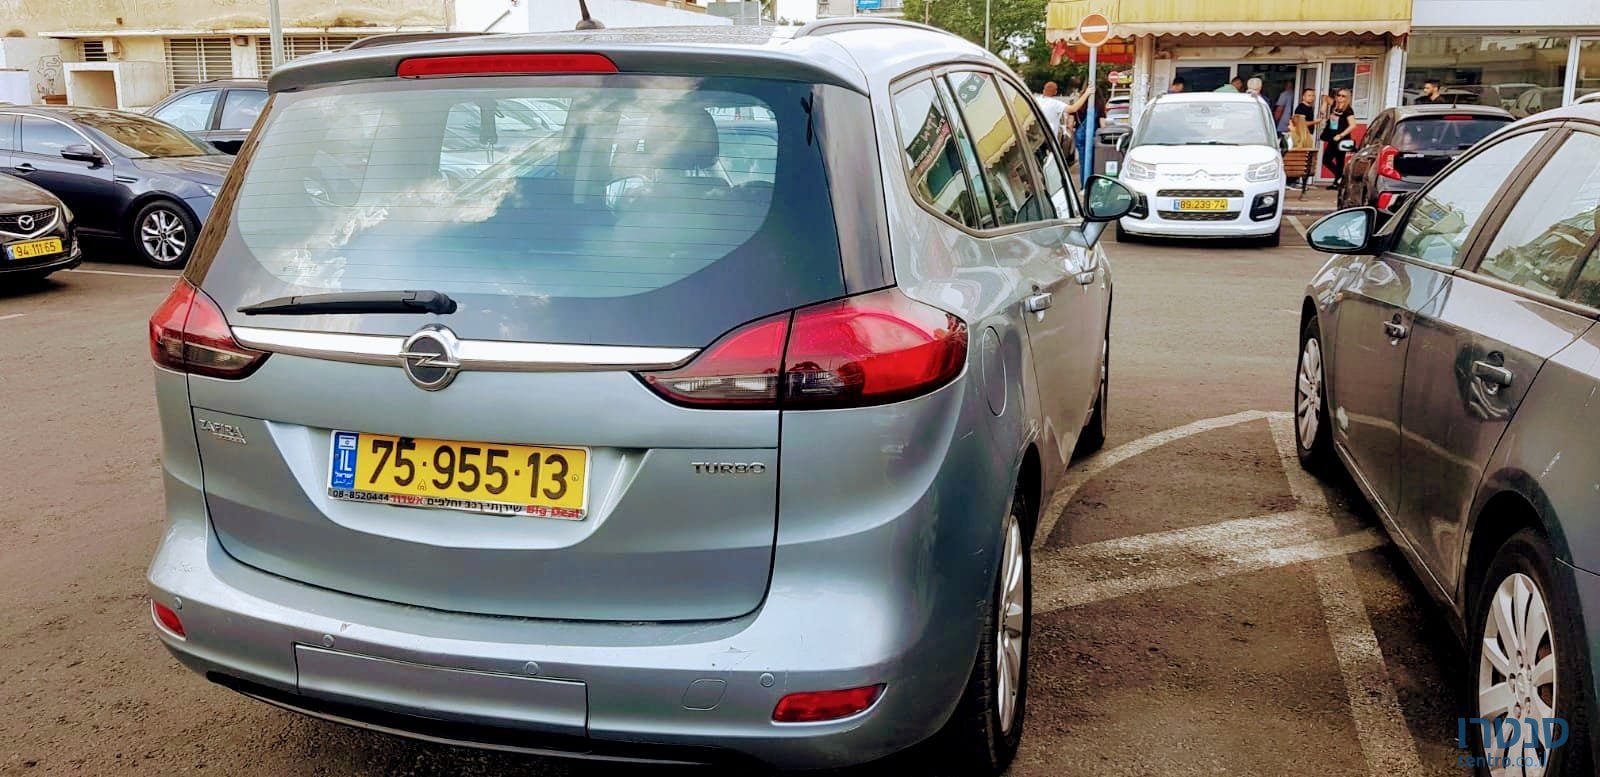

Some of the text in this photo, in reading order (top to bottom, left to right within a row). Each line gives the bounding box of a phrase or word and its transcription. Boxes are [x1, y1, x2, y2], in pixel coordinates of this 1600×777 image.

[199, 418, 244, 438] ZAFIRA
[340, 449, 352, 470] IL
[691, 461, 766, 474] TURBO
[332, 490, 389, 501] 08-8520444
[390, 494, 425, 504] אשדוד
